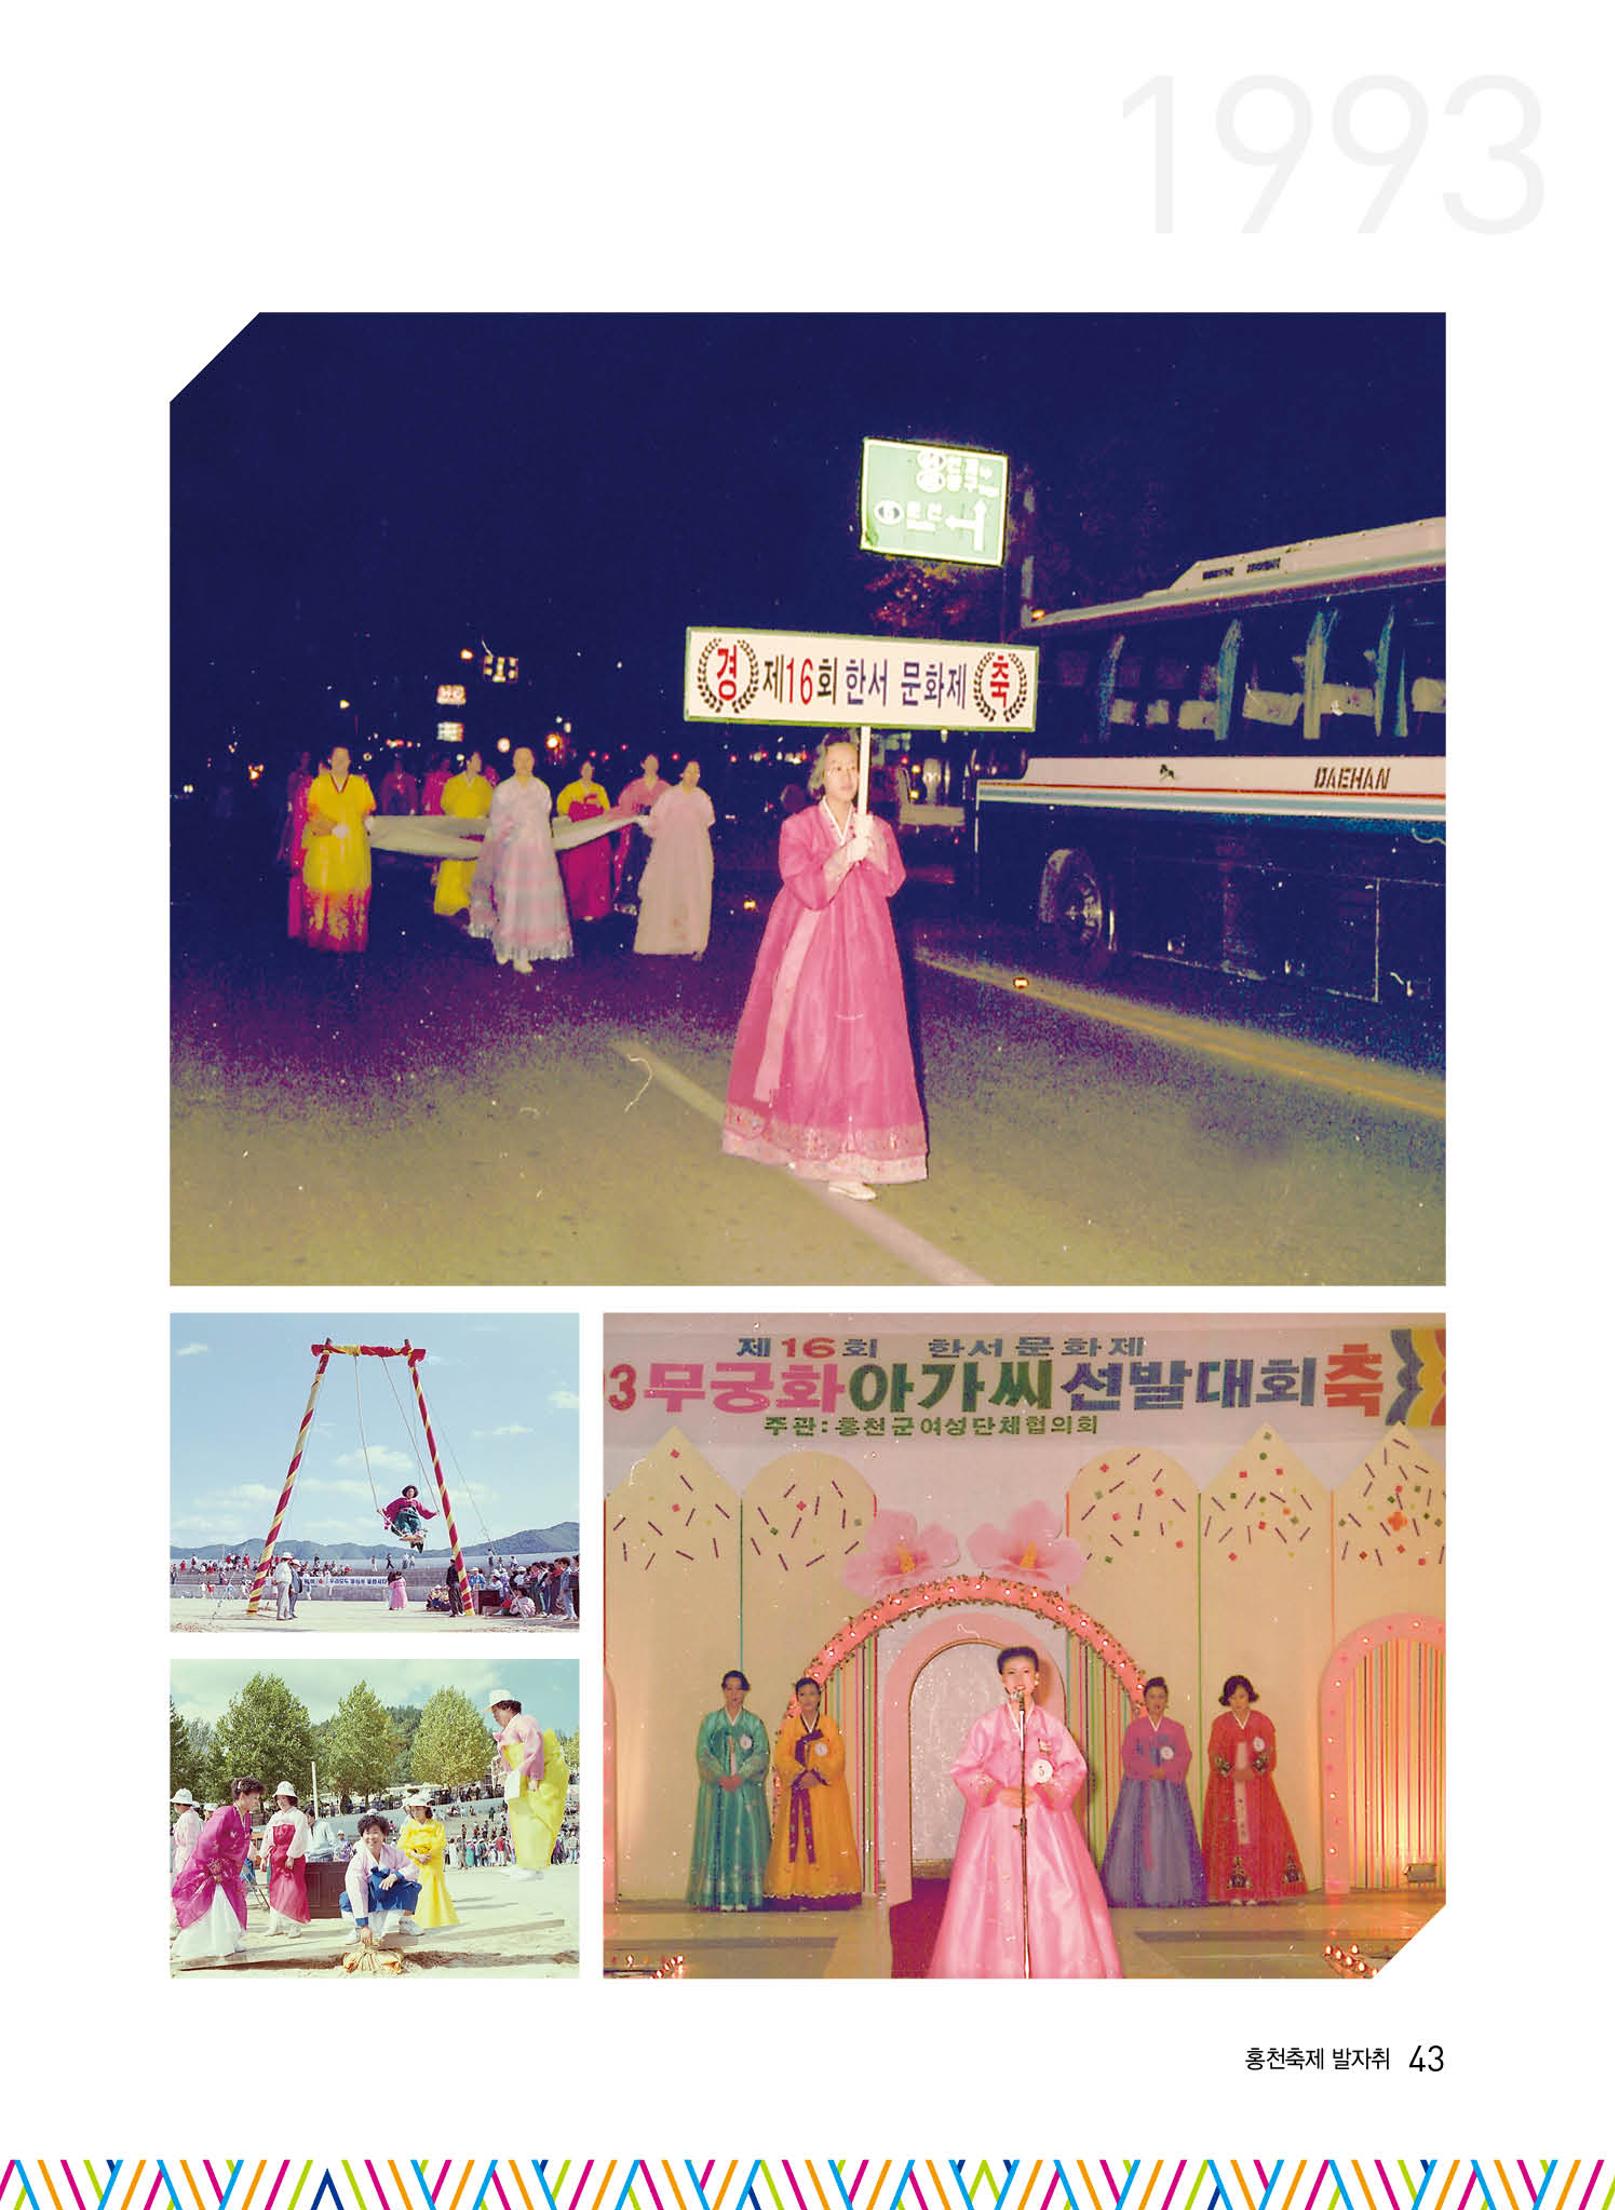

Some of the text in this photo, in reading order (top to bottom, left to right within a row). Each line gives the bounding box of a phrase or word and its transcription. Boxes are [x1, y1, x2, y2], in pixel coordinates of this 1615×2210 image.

[716, 645, 737, 701] 경
[763, 654, 968, 709] 제16회 한서 문화제
[989, 653, 1010, 708] 축
[1314, 766, 1391, 790] DAEHAN
